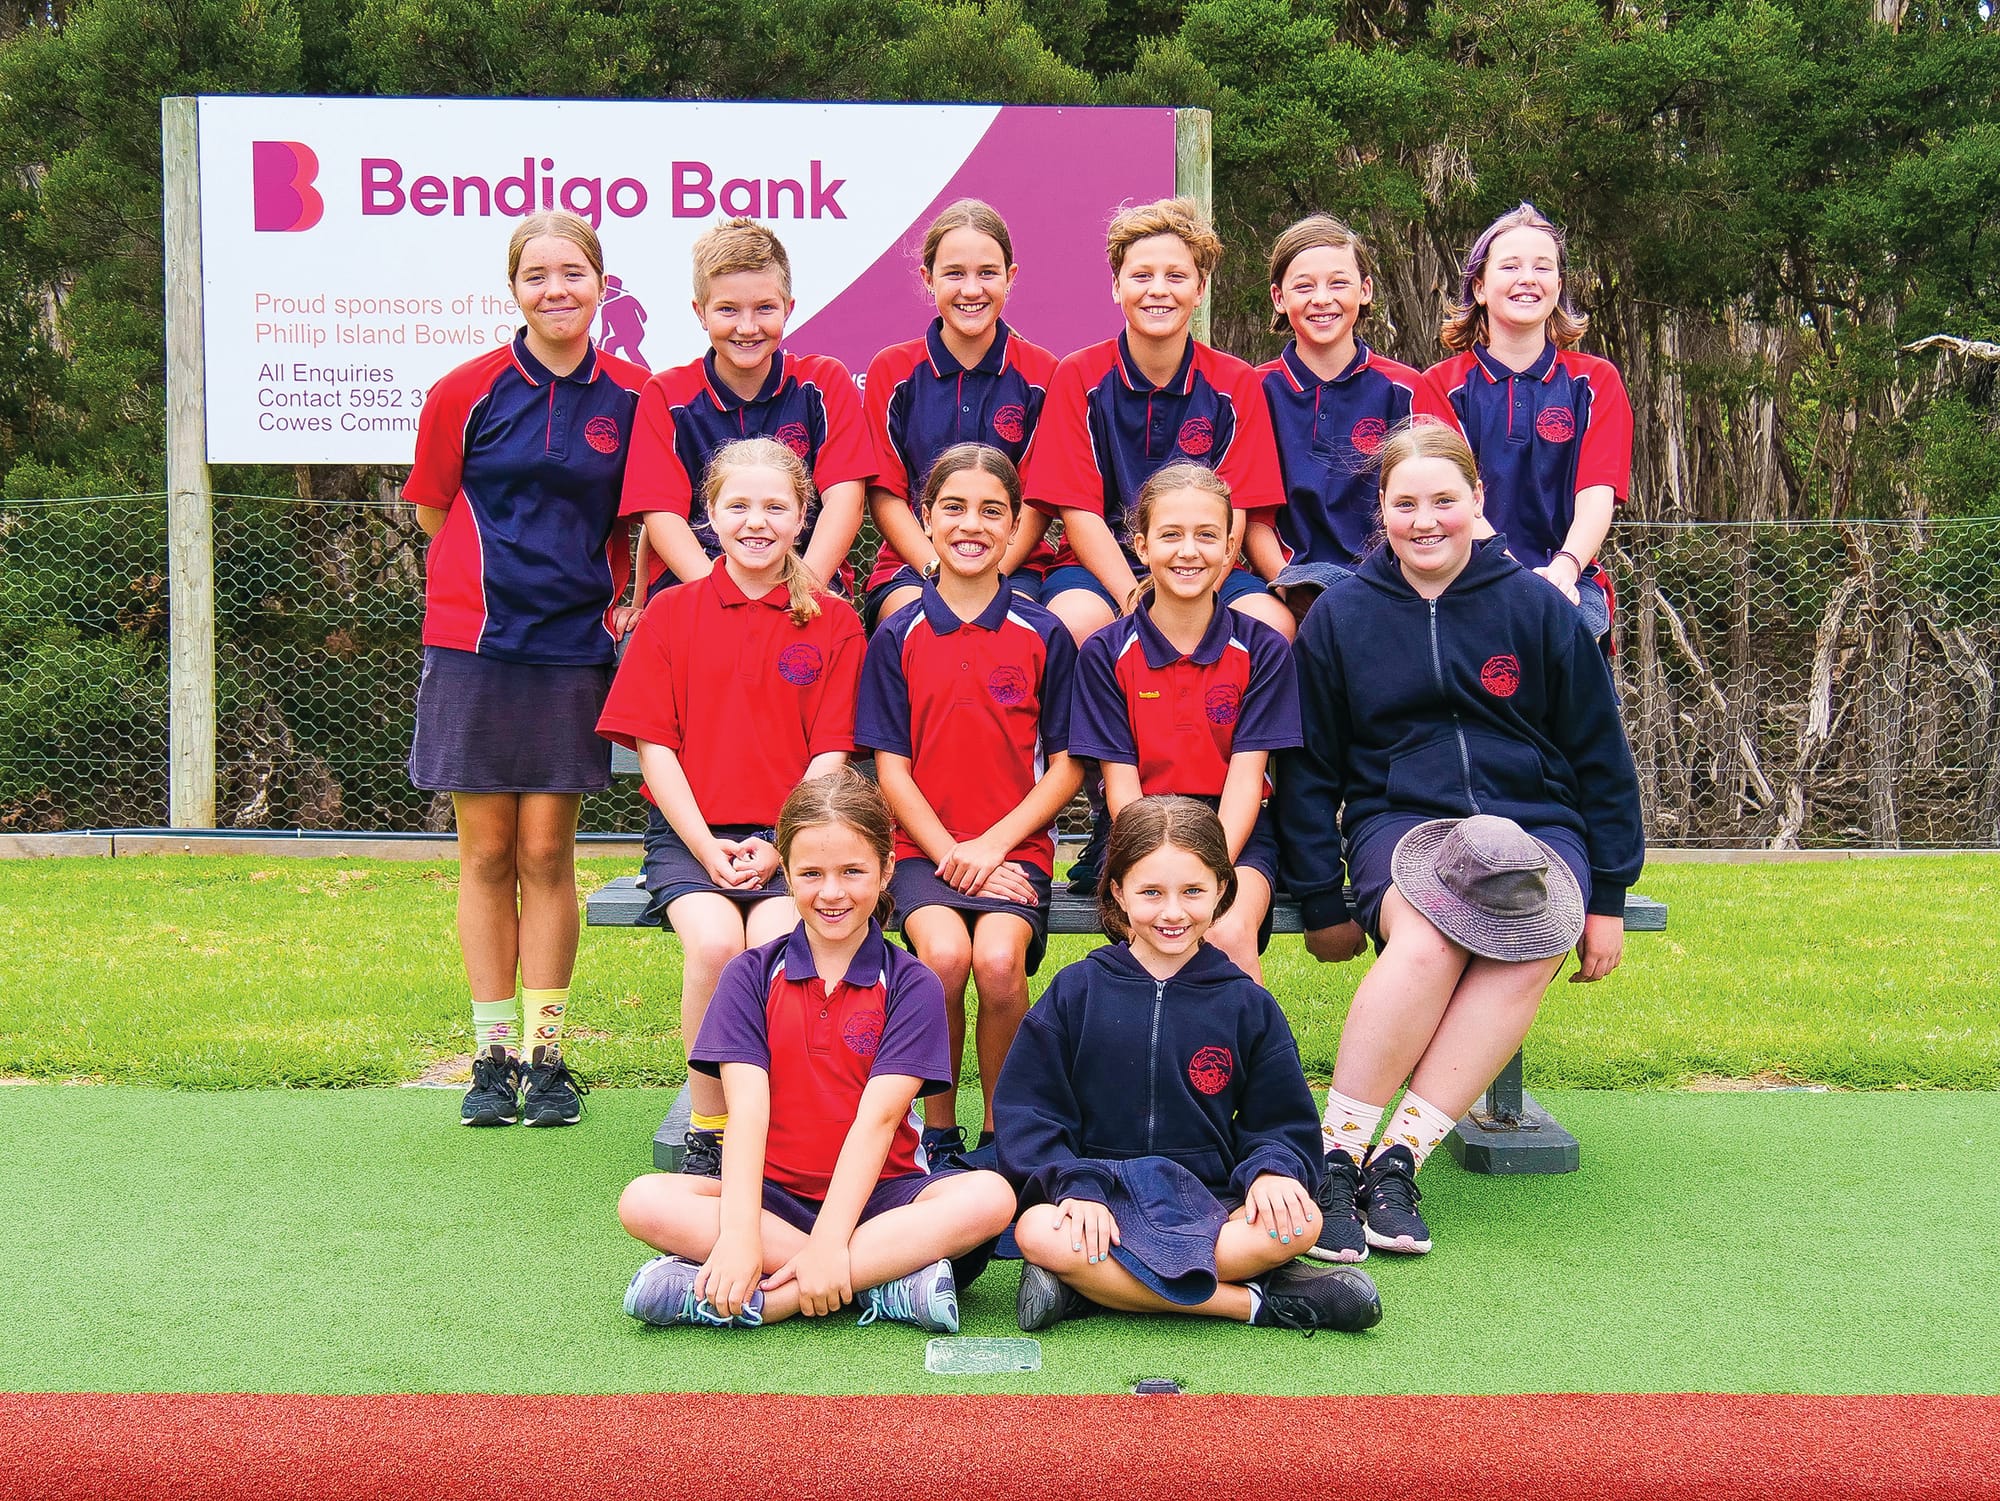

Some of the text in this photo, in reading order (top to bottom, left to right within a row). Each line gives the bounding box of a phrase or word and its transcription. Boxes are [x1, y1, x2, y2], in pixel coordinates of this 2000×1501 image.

[360, 156, 848, 232] Bendigo Bank
[255, 293, 517, 319] Proud sponsors of the
[256, 323, 327, 349] Phillip
[336, 324, 405, 345] Island
[415, 324, 485, 345] Bowls
[258, 363, 394, 386] All Enquiries
[258, 388, 342, 408] Contact
[350, 388, 402, 408] 5952
[258, 412, 333, 432] Cowes
